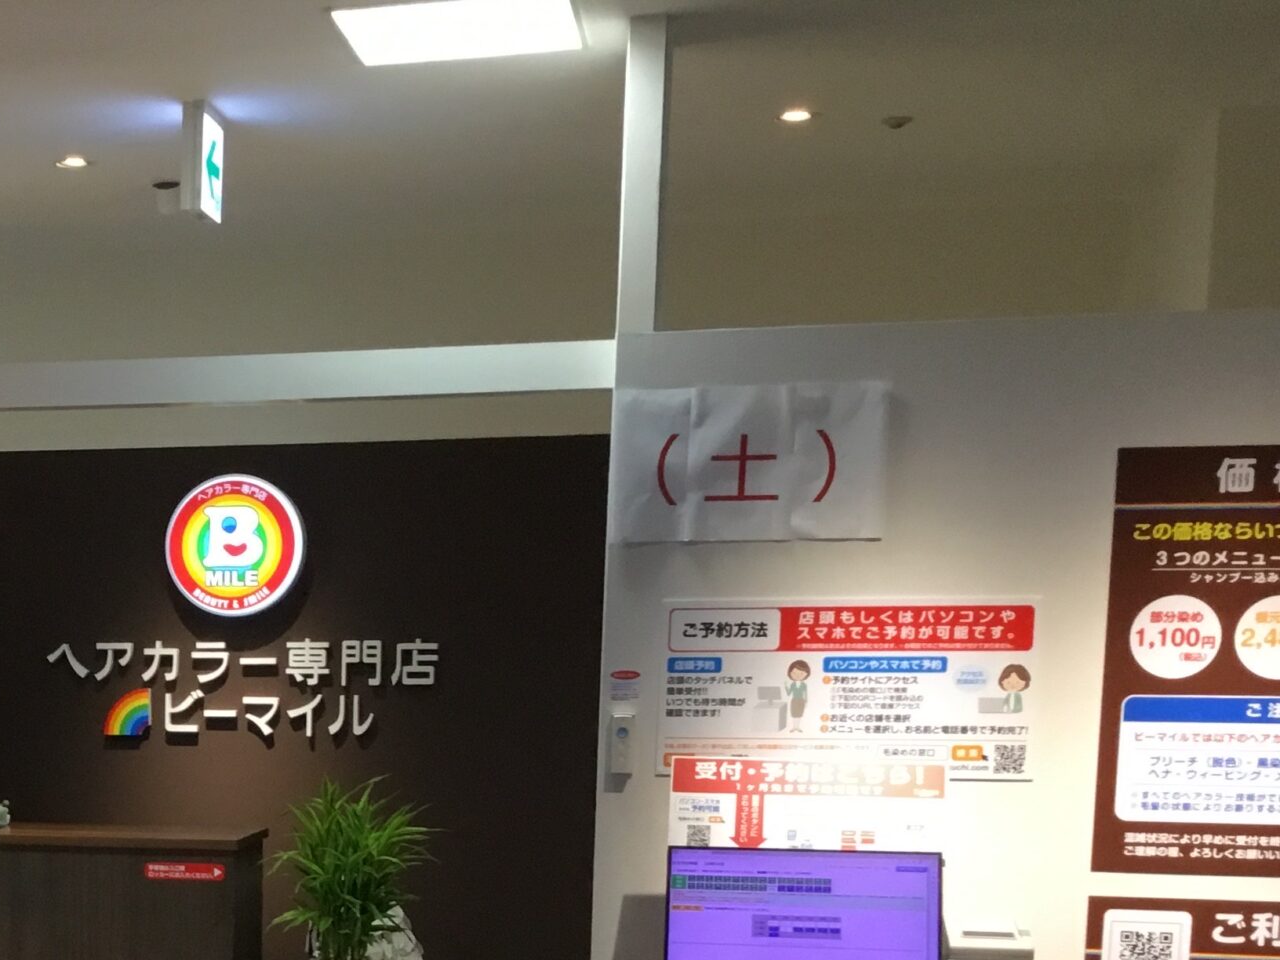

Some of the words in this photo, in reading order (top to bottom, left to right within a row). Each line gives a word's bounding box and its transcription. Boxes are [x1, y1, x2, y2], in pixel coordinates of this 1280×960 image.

[1217, 458, 1280, 493] 価
[197, 483, 269, 502] ヘアカラー専門店
[202, 505, 264, 568] B
[205, 570, 259, 587] MILE
[798, 610, 1016, 625] 店頭もしくはパソコンや
[683, 621, 768, 638] ご予約方法
[796, 626, 1016, 640] スマホでご予約が可能です。
[1136, 628, 1216, 649] 1,100円
[1241, 628, 1280, 648] 2,4
[47, 638, 440, 687] ヘアカラー専門店
[829, 659, 943, 670] パソコンやスマホで予約
[165, 688, 375, 738] ビーマイル
